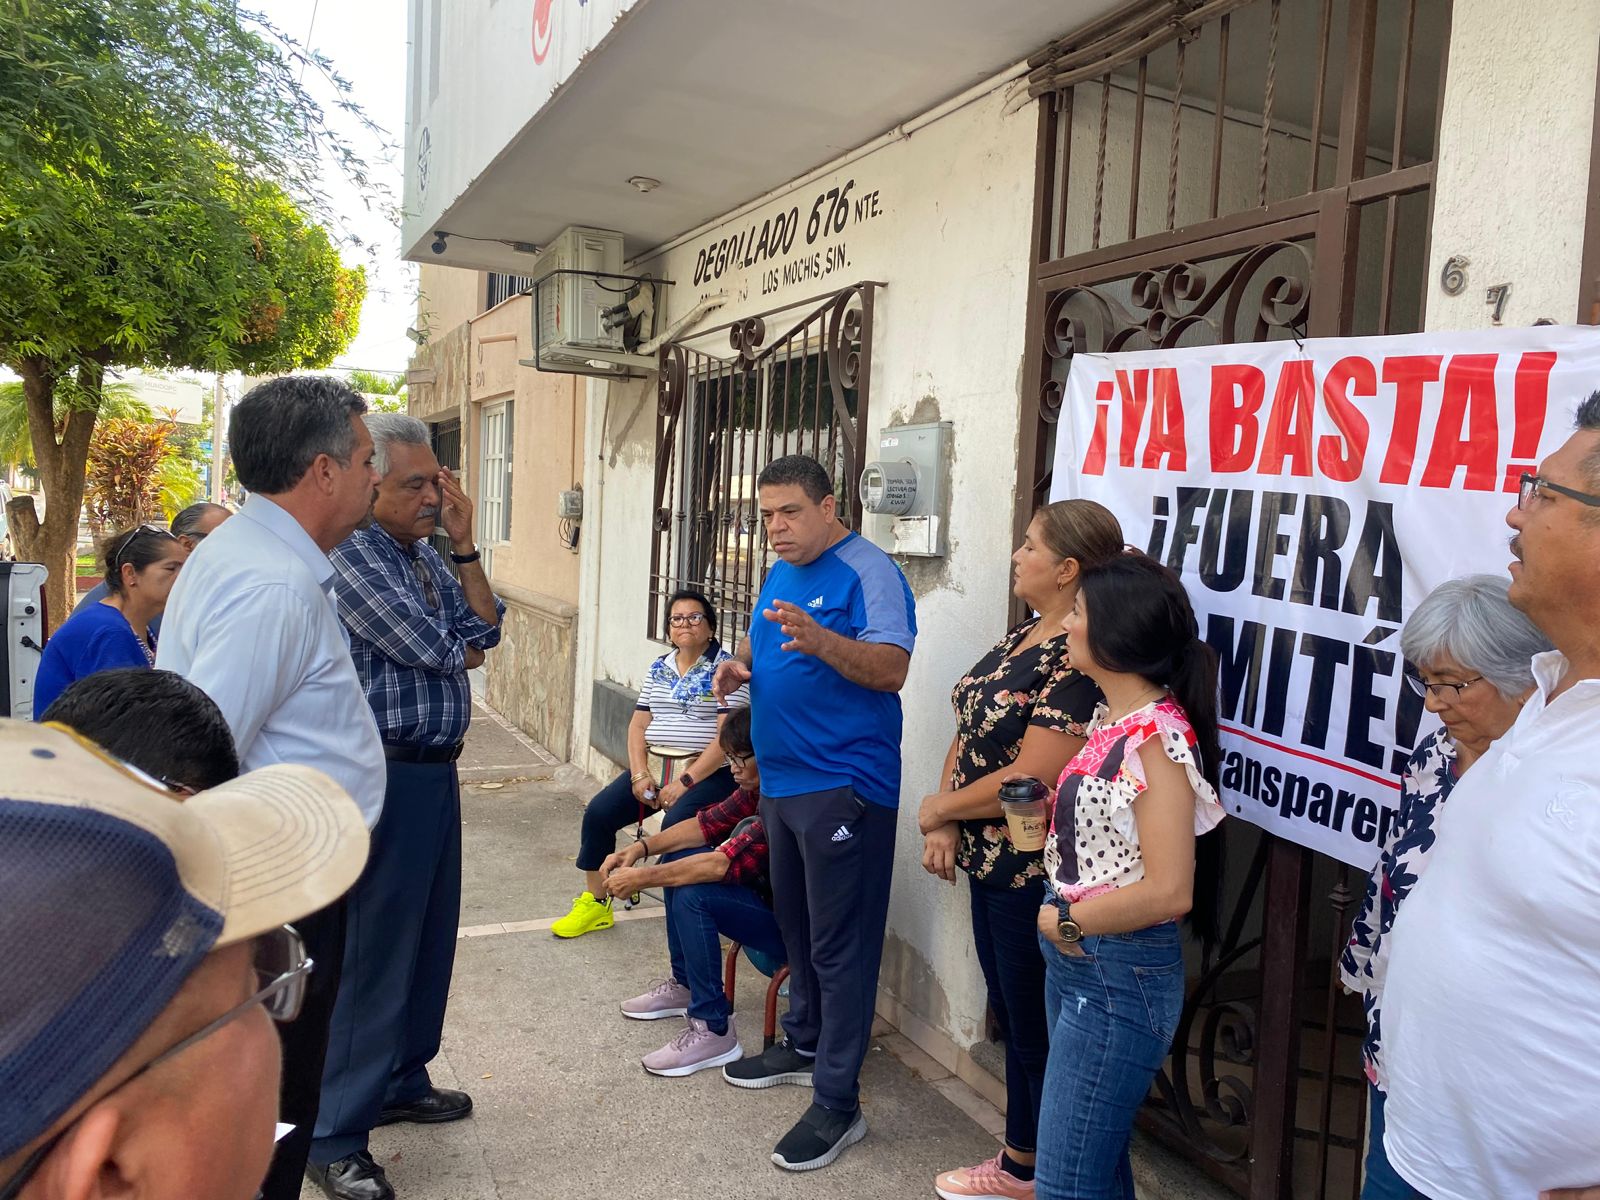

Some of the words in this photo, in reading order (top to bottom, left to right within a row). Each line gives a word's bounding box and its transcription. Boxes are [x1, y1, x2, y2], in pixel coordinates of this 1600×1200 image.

[806, 179, 855, 245] 676
[854, 190, 883, 225] NTE.
[762, 269, 779, 295] LOS
[1081, 367, 1187, 476] ¡YA
[1209, 351, 1558, 493] BASTA!
[1147, 486, 1403, 624] ¡FUERA
